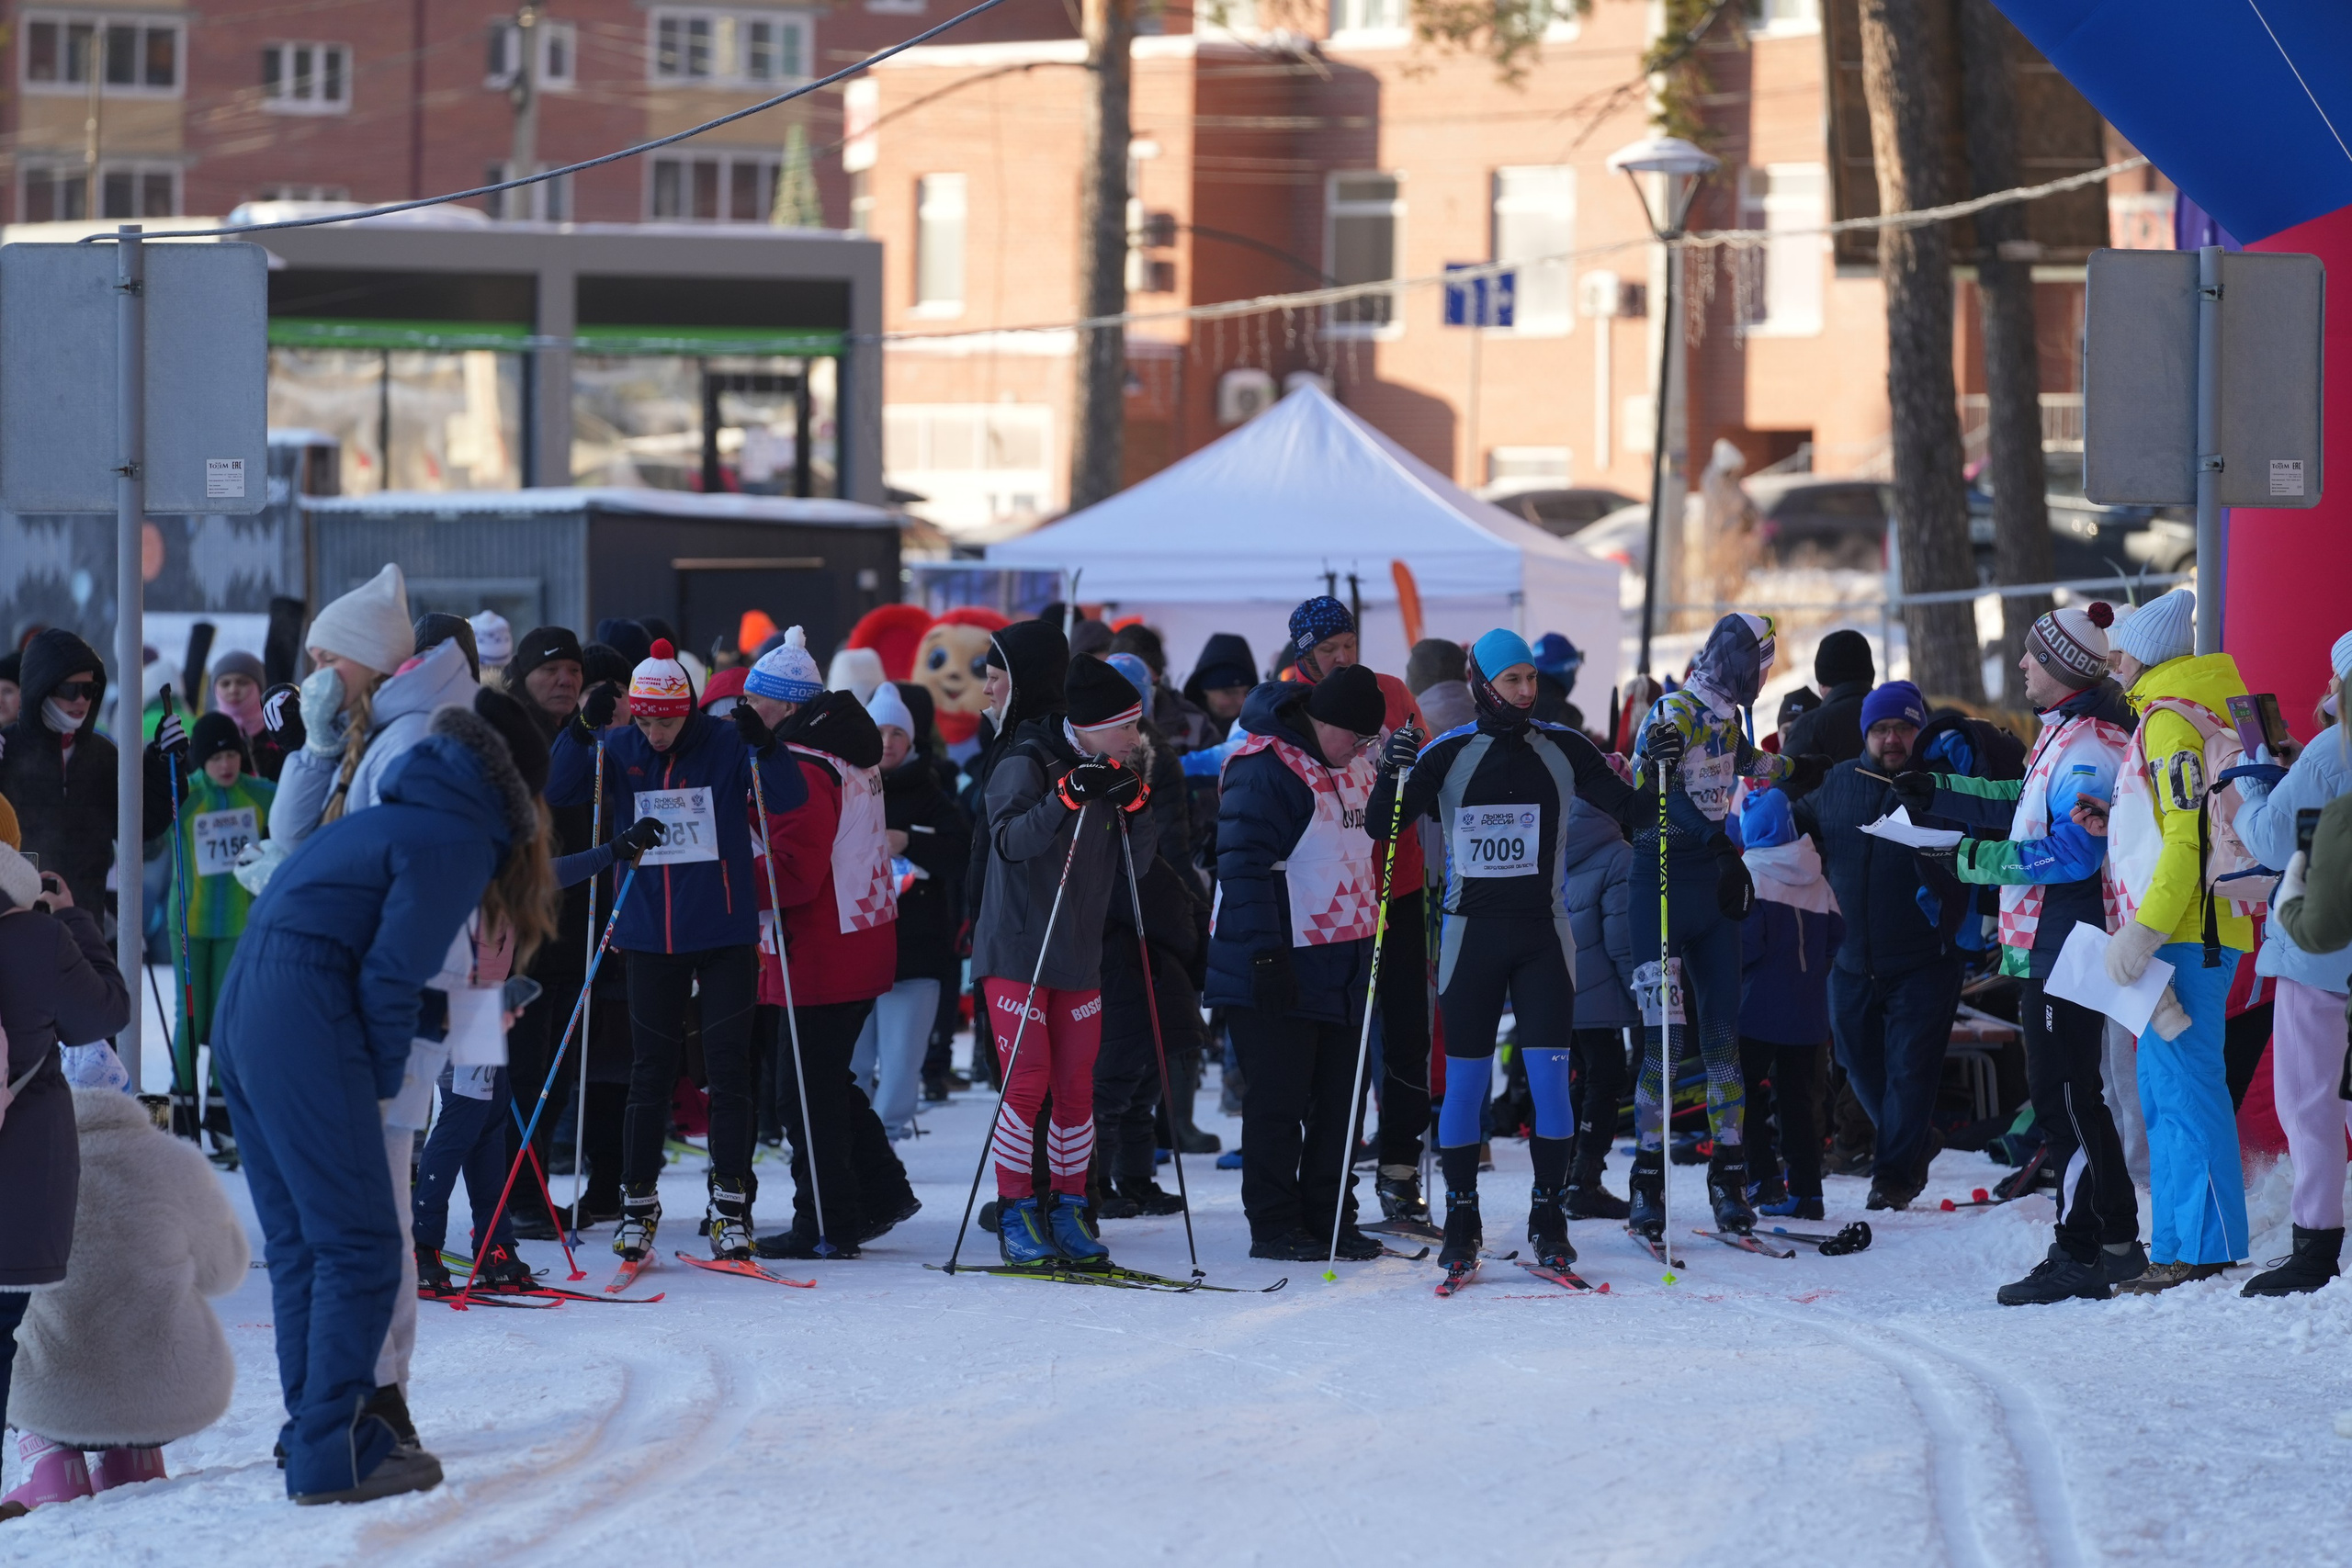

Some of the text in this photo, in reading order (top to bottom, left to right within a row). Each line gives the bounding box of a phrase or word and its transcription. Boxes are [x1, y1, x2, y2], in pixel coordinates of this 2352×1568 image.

[1470, 838, 1525, 862] 7009
[2033, 856, 2055, 867] CODE
[1070, 994, 1102, 1022] BOSC
